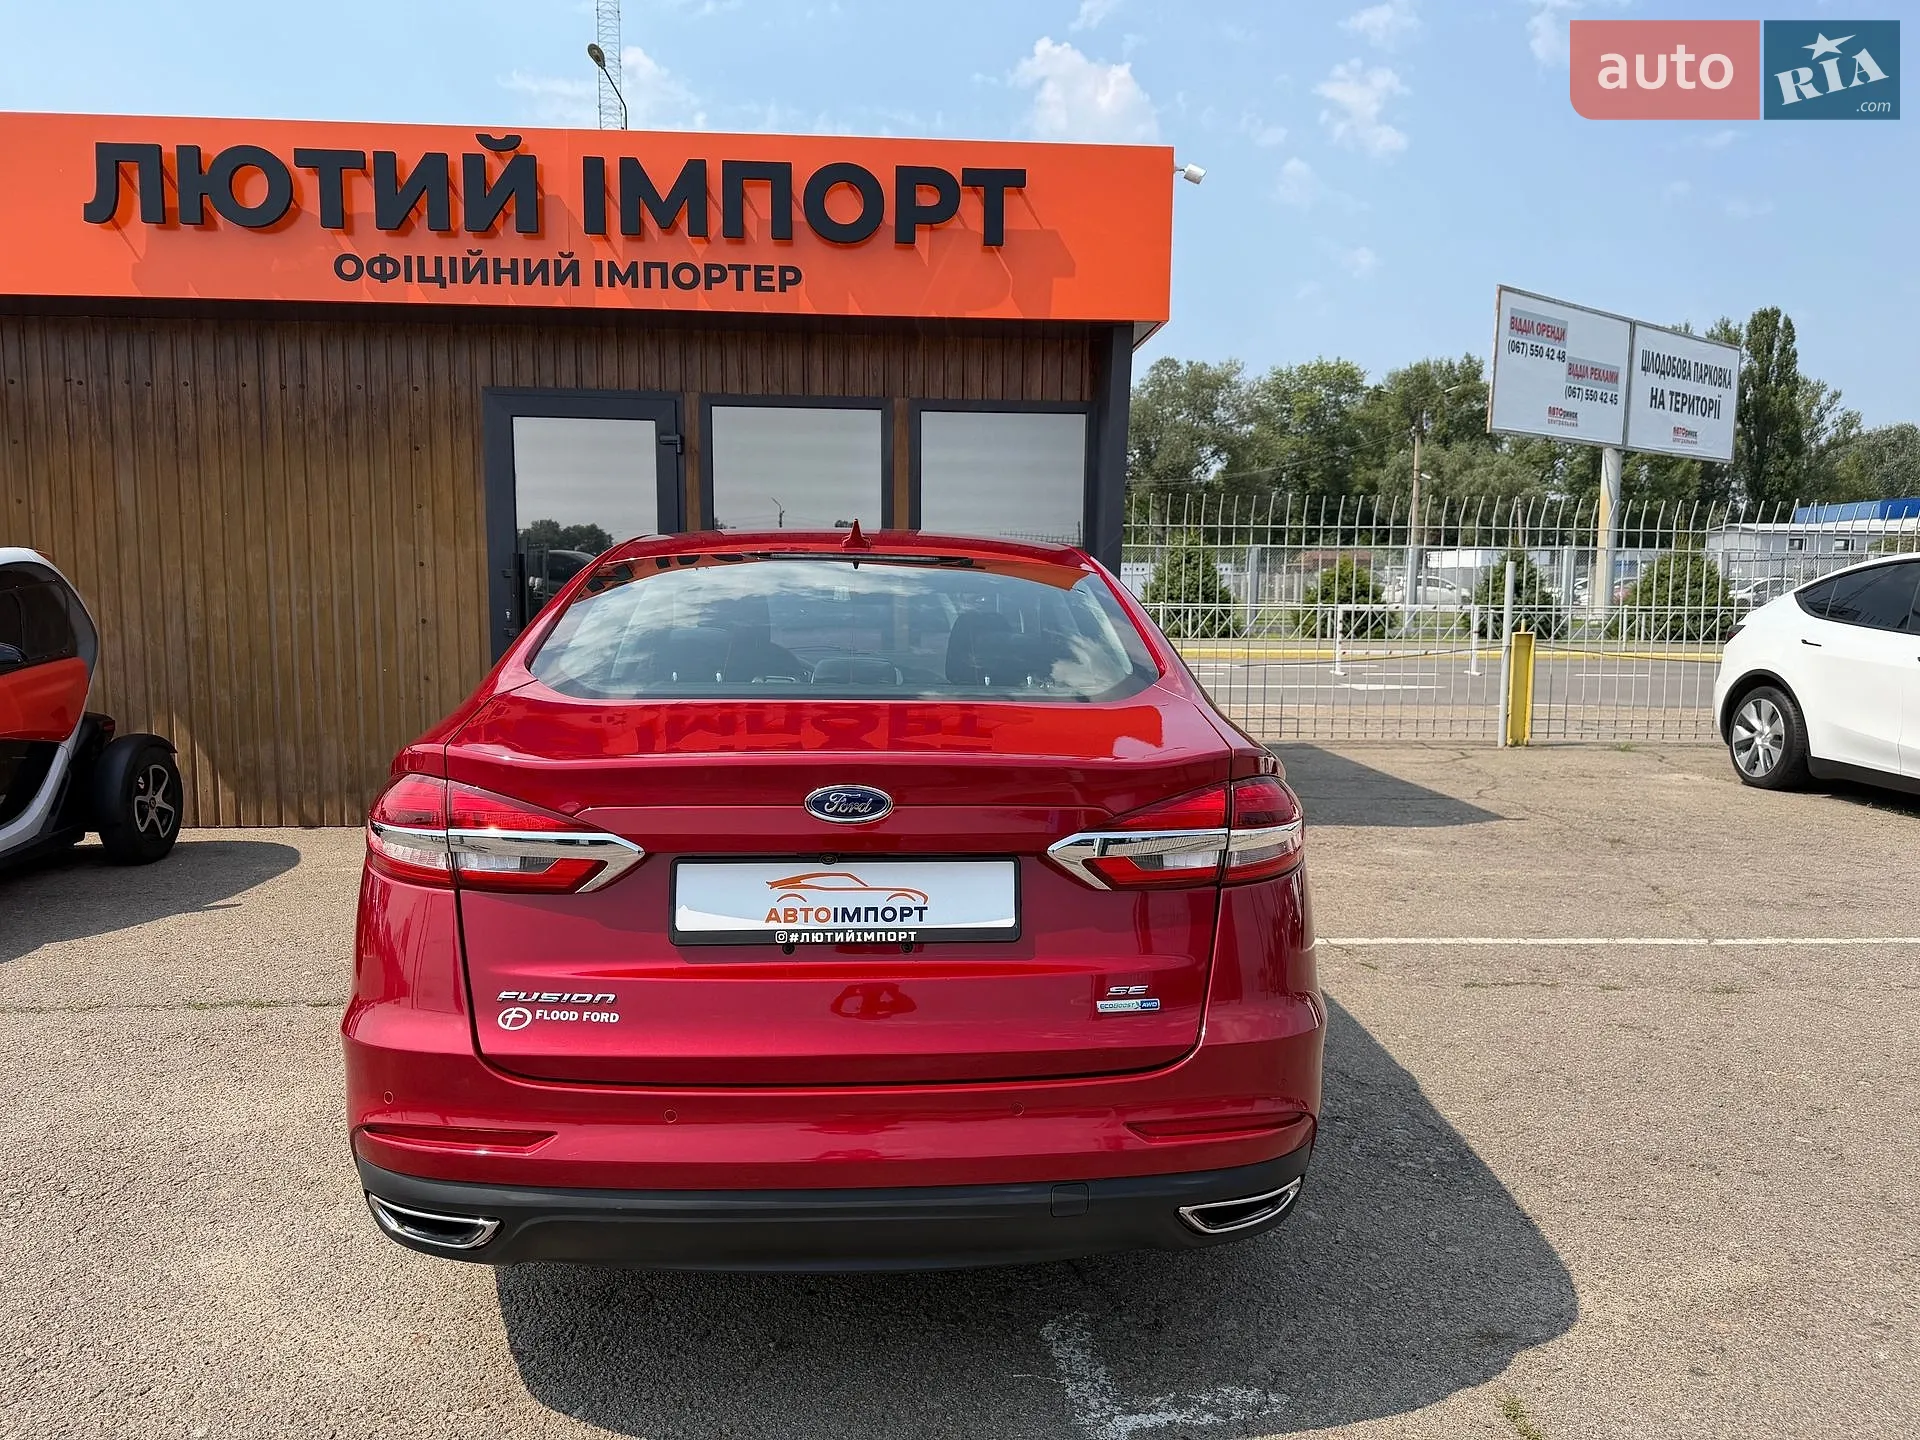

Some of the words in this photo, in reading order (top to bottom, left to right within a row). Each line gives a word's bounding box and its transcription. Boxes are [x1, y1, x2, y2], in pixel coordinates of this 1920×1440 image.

[83, 133, 539, 235] ЛЮТИЙ
[582, 155, 1027, 247] ІМПОРТ
[334, 249, 580, 289] ОФІЦІЙНИЙ
[594, 259, 803, 293] ІМПОРТЕР
[1510, 316, 1534, 336] ВІДДІЛ
[1536, 322, 1566, 343] ОРЕНДИ
[1508, 340, 1528, 357] (067)
[1529, 344, 1544, 358] 550
[1545, 347, 1555, 360] 42
[1556, 350, 1566, 362] 48
[1567, 362, 1589, 380] ВІДДІЛ
[1590, 366, 1619, 384] РЕКЛАМИ
[1641, 349, 1692, 381] ЦІЛОДОБОВА
[1693, 362, 1732, 390] ПАРКОВКА
[1564, 385, 1584, 402] (067)
[1584, 389, 1598, 402] 550
[1599, 391, 1608, 404] 42
[1609, 393, 1618, 405] 45
[1650, 386, 1666, 410] НА
[1669, 390, 1722, 420] ТЕРИТОРІЇ
[824, 792, 873, 813] Ford
[764, 905, 929, 924] АВТОІМПОРТ
[788, 929, 917, 943] #ЛЮТИЙІМПОРТ
[496, 990, 616, 1004] FUSION
[1106, 984, 1149, 997] SE
[535, 1009, 579, 1021] FLOOD
[583, 1011, 620, 1023] FORD
